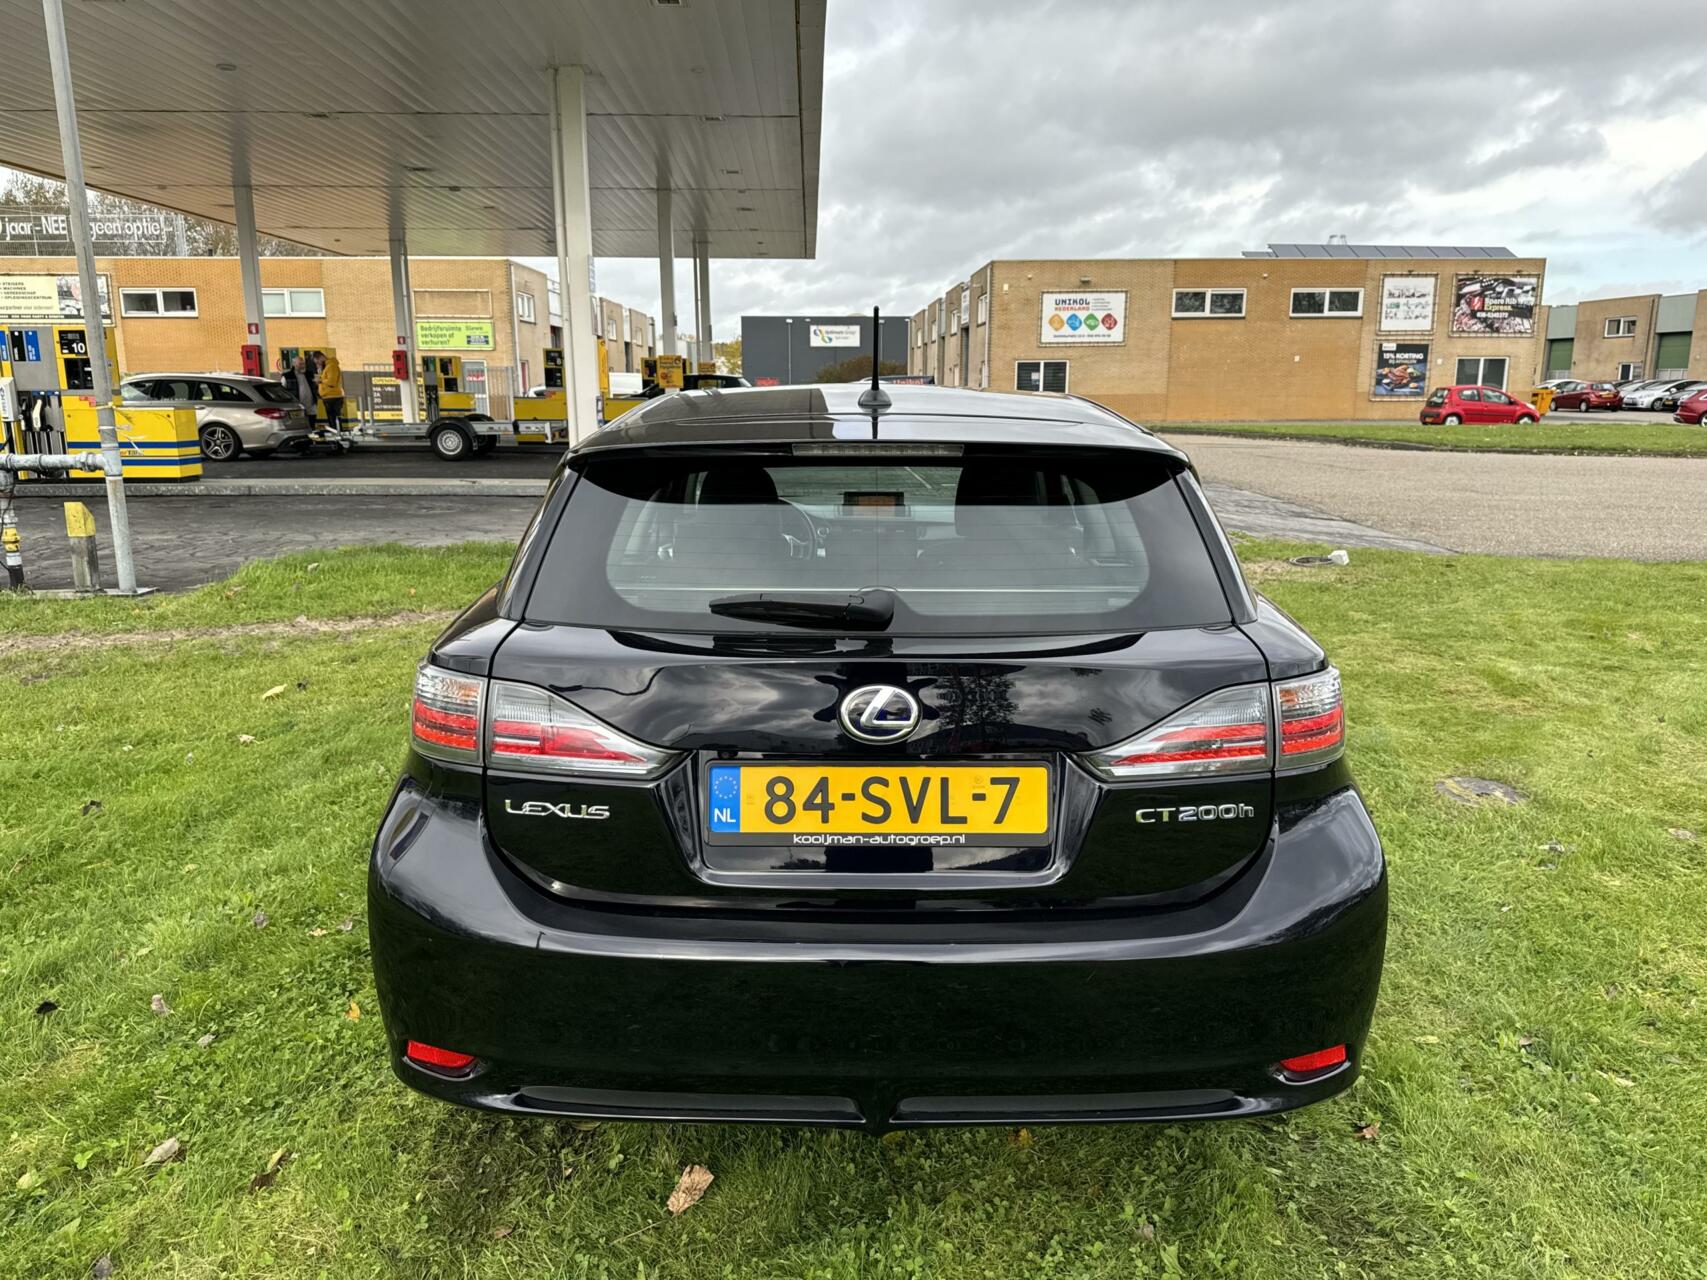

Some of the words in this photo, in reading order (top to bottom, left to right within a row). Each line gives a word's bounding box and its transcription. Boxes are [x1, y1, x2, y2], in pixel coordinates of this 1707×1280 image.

[125, 218, 161, 241] optie
[1055, 298, 1090, 306] UNIHOL
[72, 342, 86, 354] 10
[1395, 352, 1424, 360] KORTING
[764, 776, 1021, 824] 84-SVL-7
[504, 799, 611, 820] LEXUS
[713, 807, 737, 823] NL
[793, 834, 966, 845] kooijman-autogroep.nl
